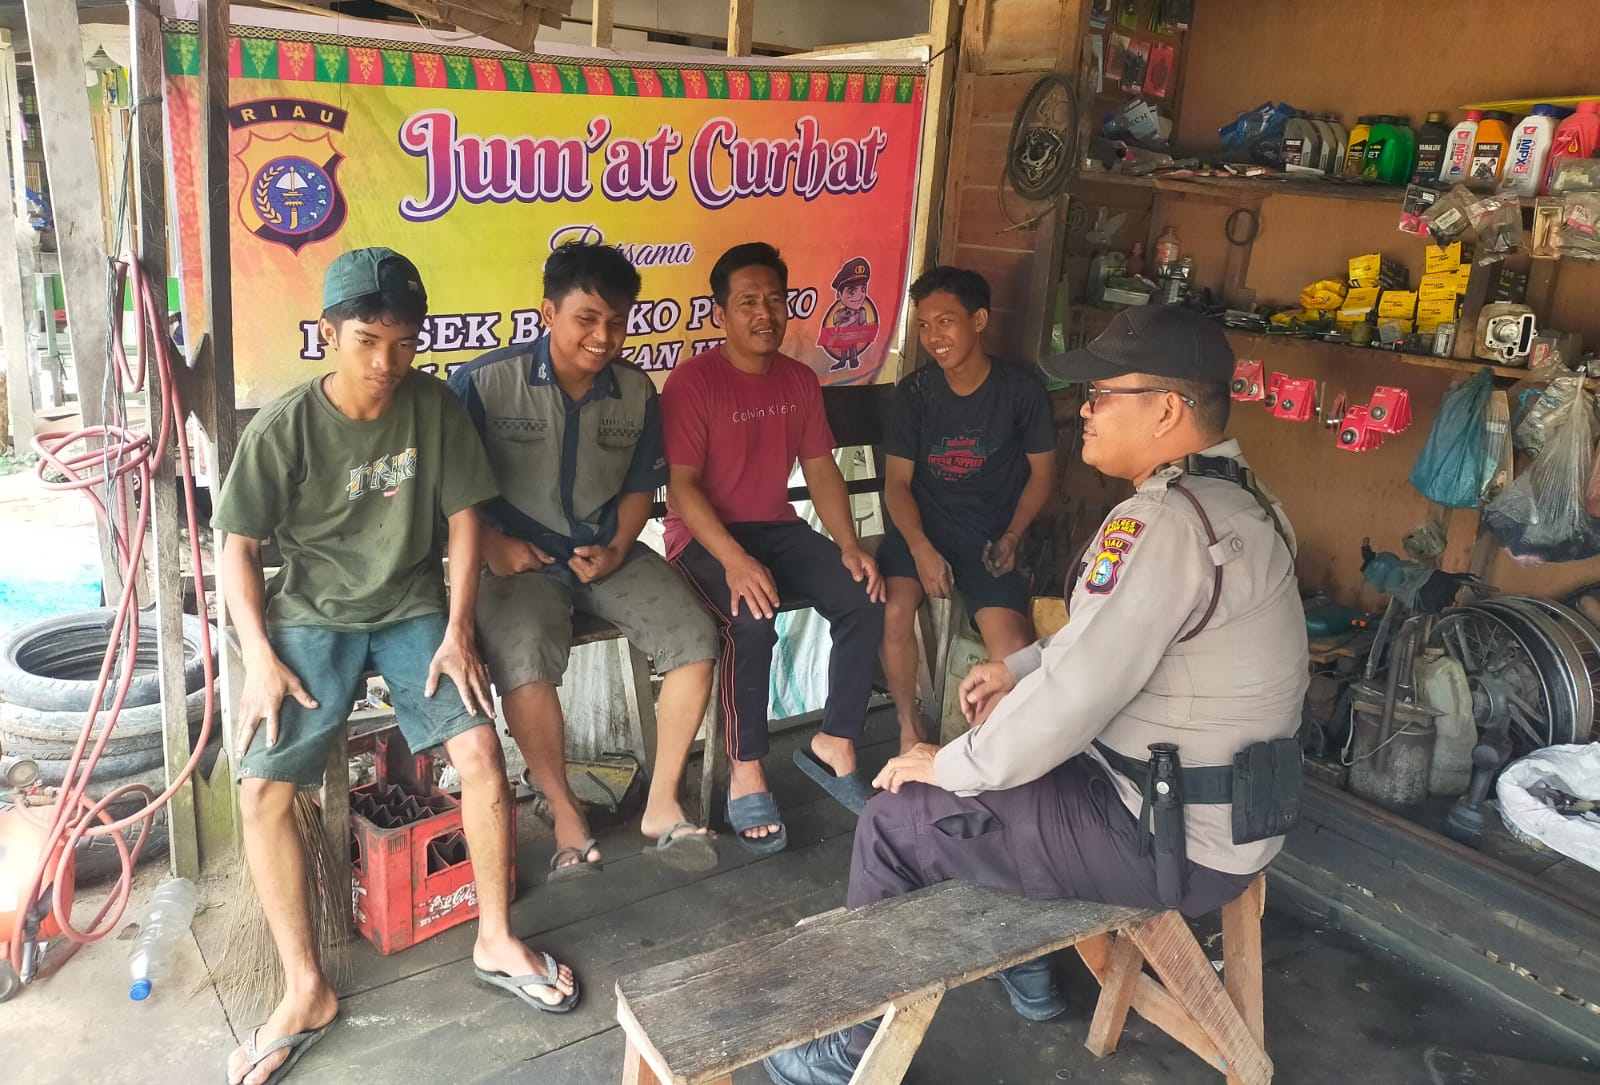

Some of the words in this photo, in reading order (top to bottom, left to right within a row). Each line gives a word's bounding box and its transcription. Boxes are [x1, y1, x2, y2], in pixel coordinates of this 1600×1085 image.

[241, 104, 335, 125] RIAU
[399, 108, 682, 223] Jum'at
[688, 114, 888, 210] Curhat
[768, 402, 797, 416] Klein
